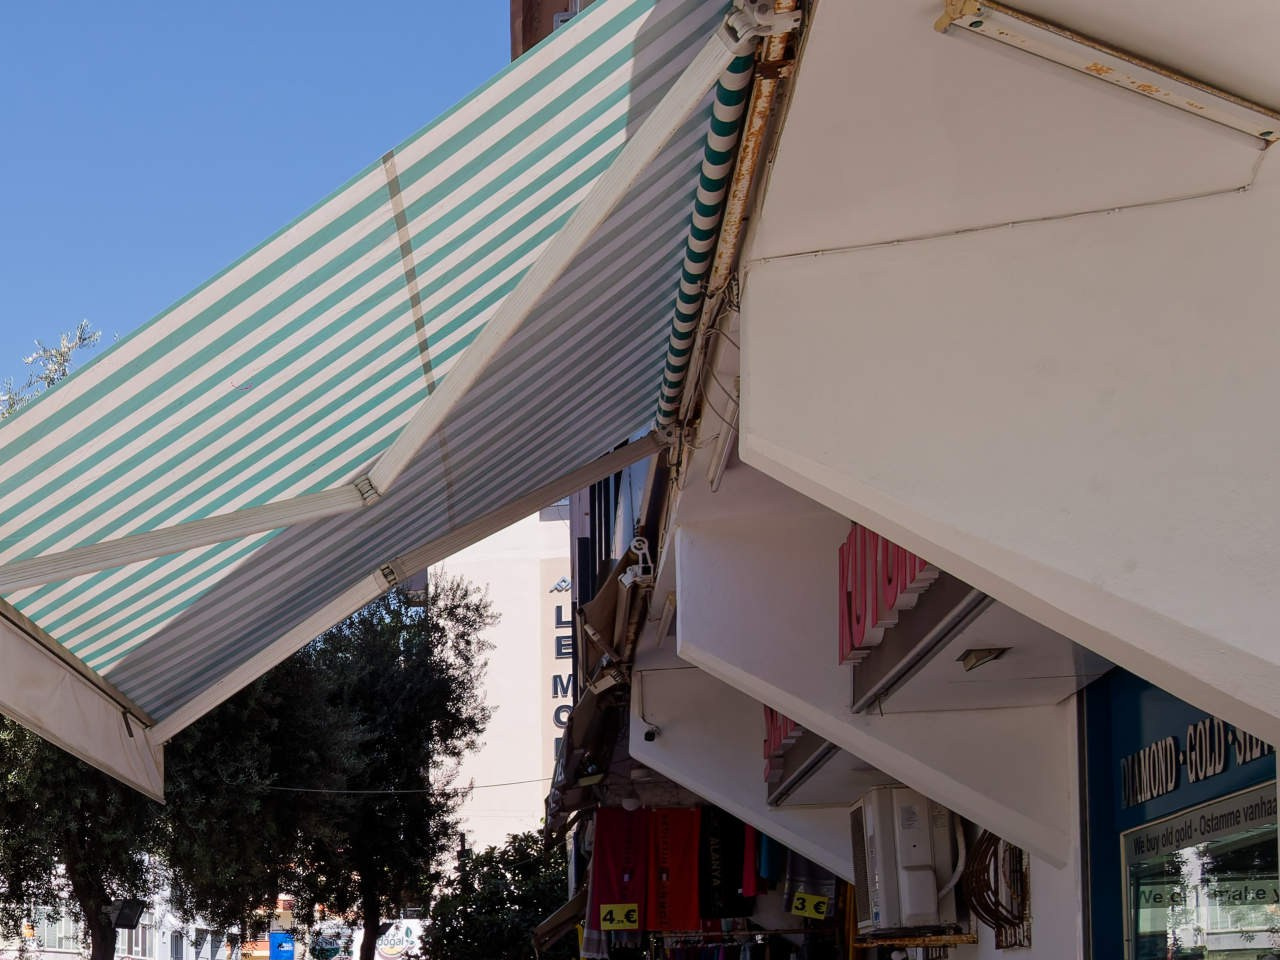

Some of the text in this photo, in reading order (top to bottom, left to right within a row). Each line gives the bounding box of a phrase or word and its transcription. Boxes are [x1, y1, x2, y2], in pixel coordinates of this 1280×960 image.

[1120, 736, 1177, 809] DIAMOND
[1186, 716, 1226, 784] GOLD
[1133, 837, 1145, 856] We
[1146, 833, 1160, 855] buy
[1161, 827, 1174, 848] old
[1175, 820, 1193, 848] gold
